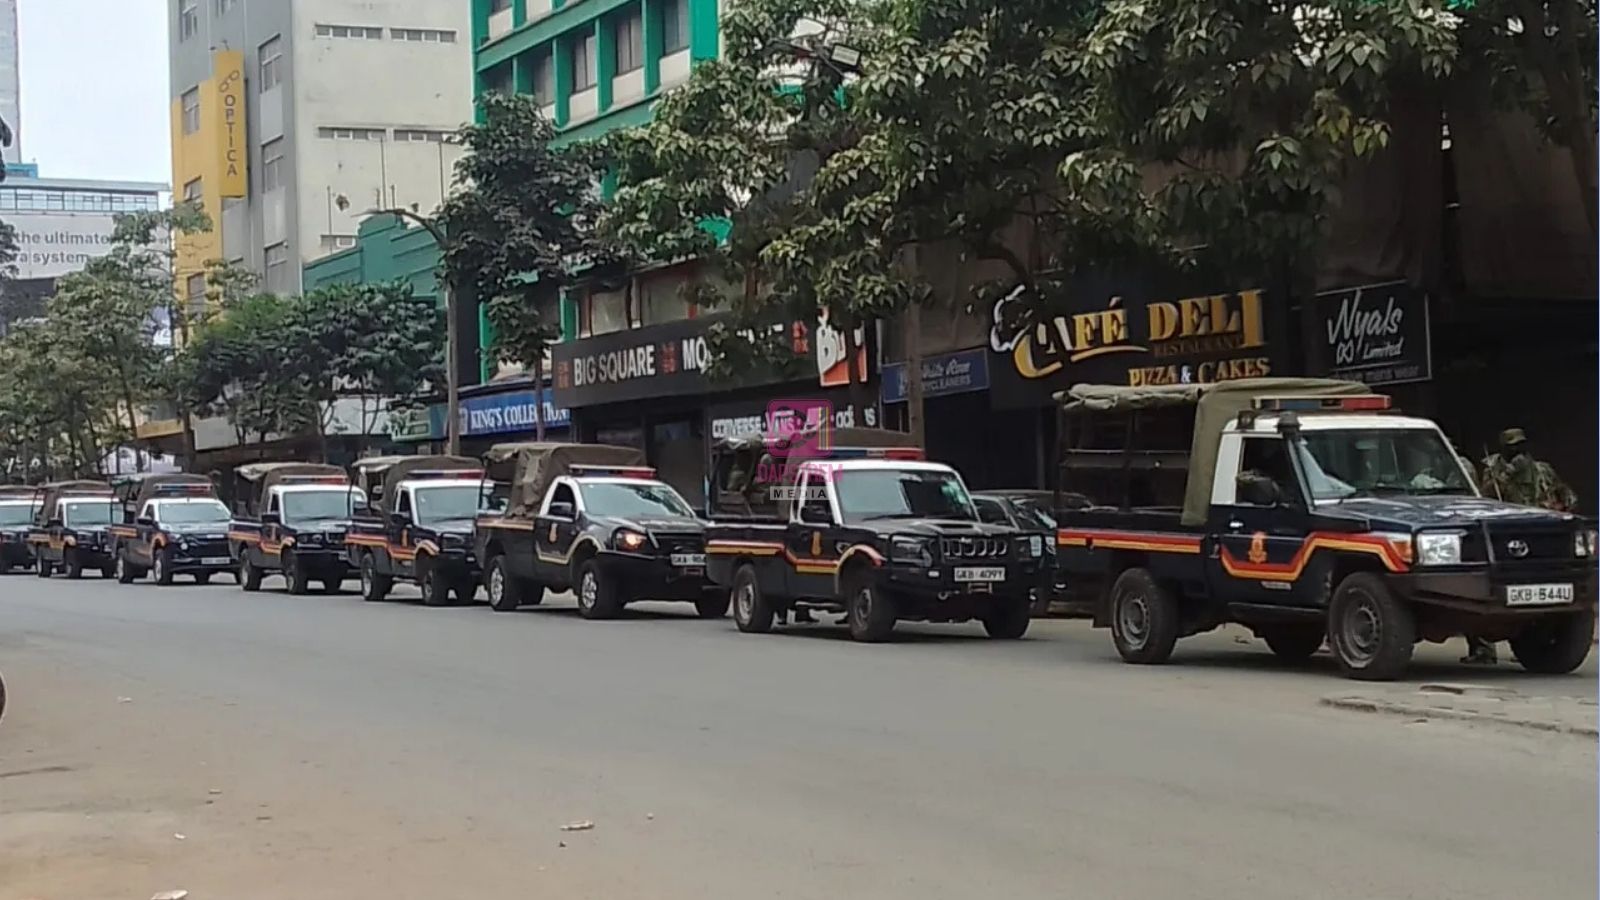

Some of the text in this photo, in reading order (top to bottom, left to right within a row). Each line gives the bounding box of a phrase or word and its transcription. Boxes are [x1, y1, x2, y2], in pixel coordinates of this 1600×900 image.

[224, 94, 238, 176] OPTICA
[16, 231, 40, 244] the
[1146, 289, 1268, 349] DELI
[1328, 287, 1404, 354] Nyals
[574, 356, 597, 386] BIG
[599, 345, 656, 383] SQUARE
[1128, 357, 1271, 387] PIZZA & CAKES
[1510, 588, 1533, 602] GKB
